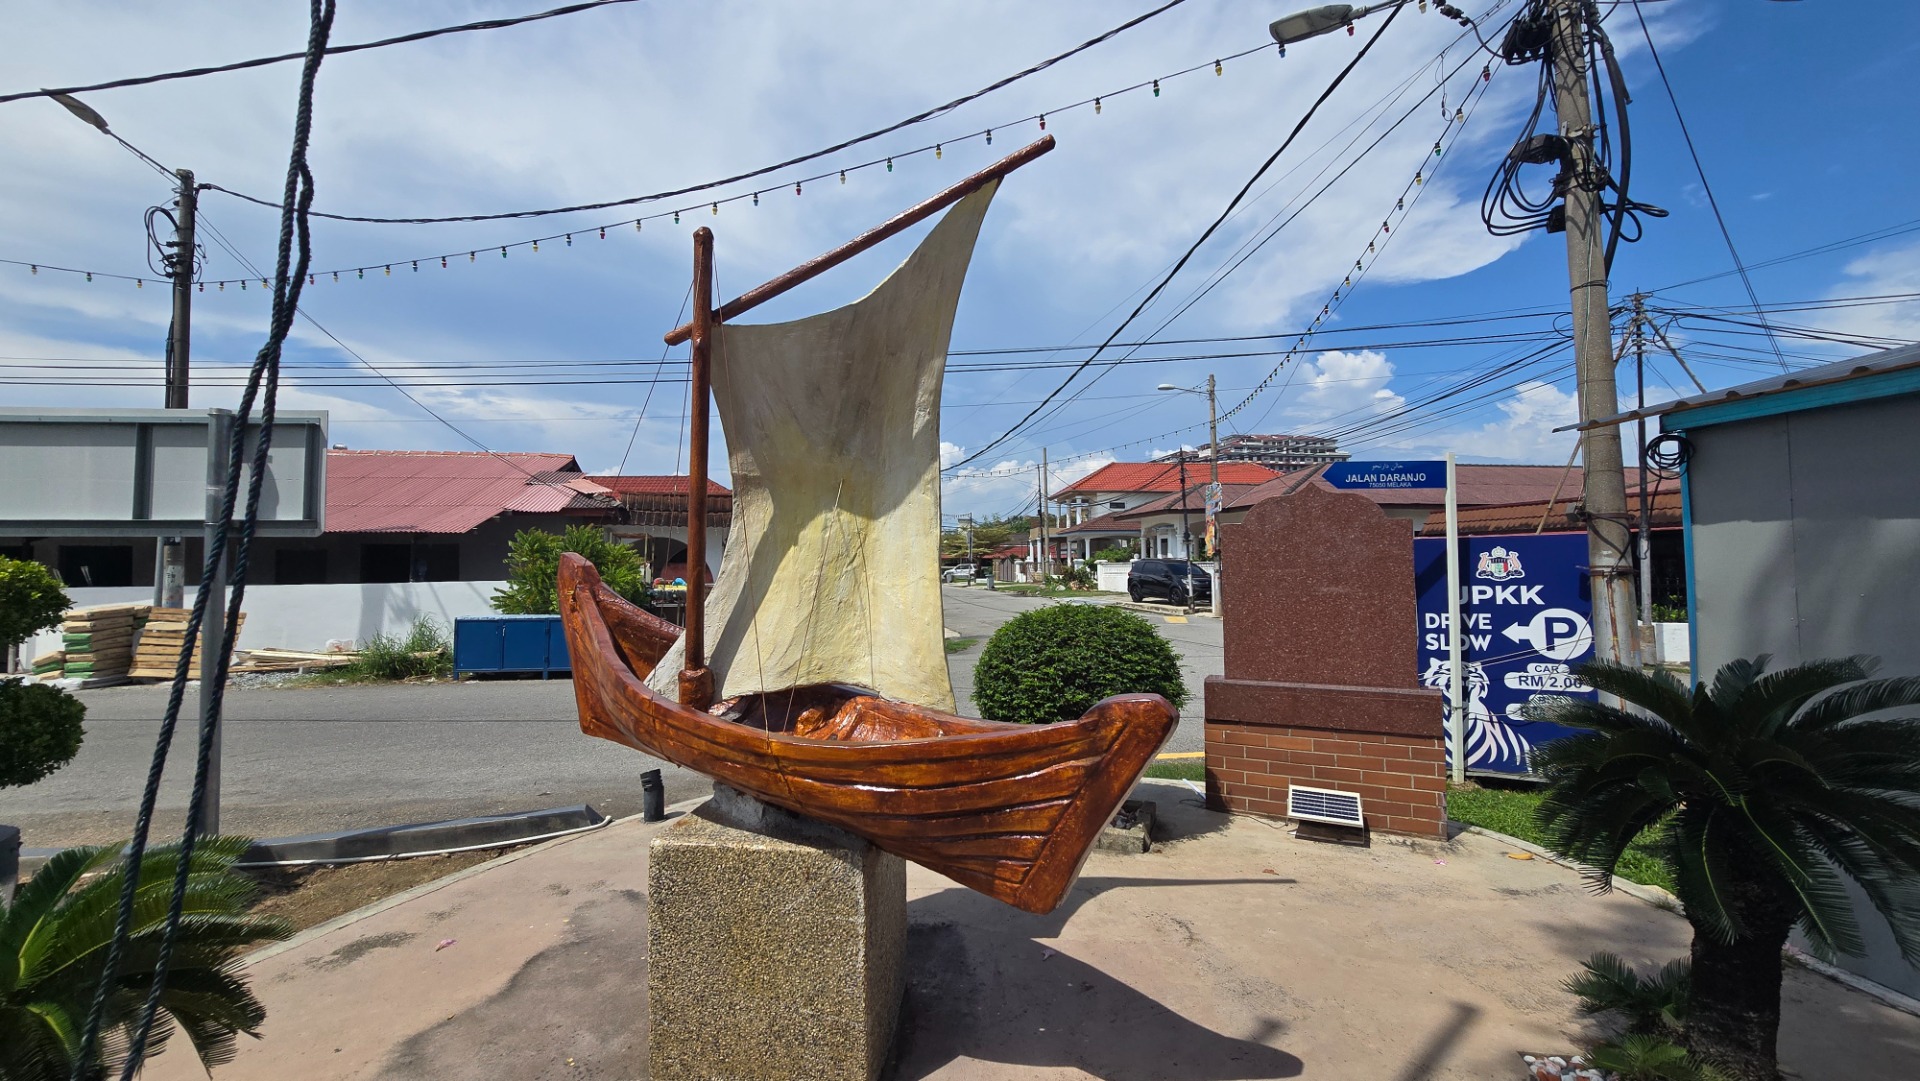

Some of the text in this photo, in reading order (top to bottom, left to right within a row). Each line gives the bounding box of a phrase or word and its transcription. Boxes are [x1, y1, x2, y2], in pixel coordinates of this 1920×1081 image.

[1345, 473, 1427, 482] JALAN DARANJO
[1425, 612, 1492, 630] DRVE
[1545, 616, 1578, 652] P
[1534, 665, 1559, 673] CAR
[1518, 675, 1583, 689] RM 2.00
